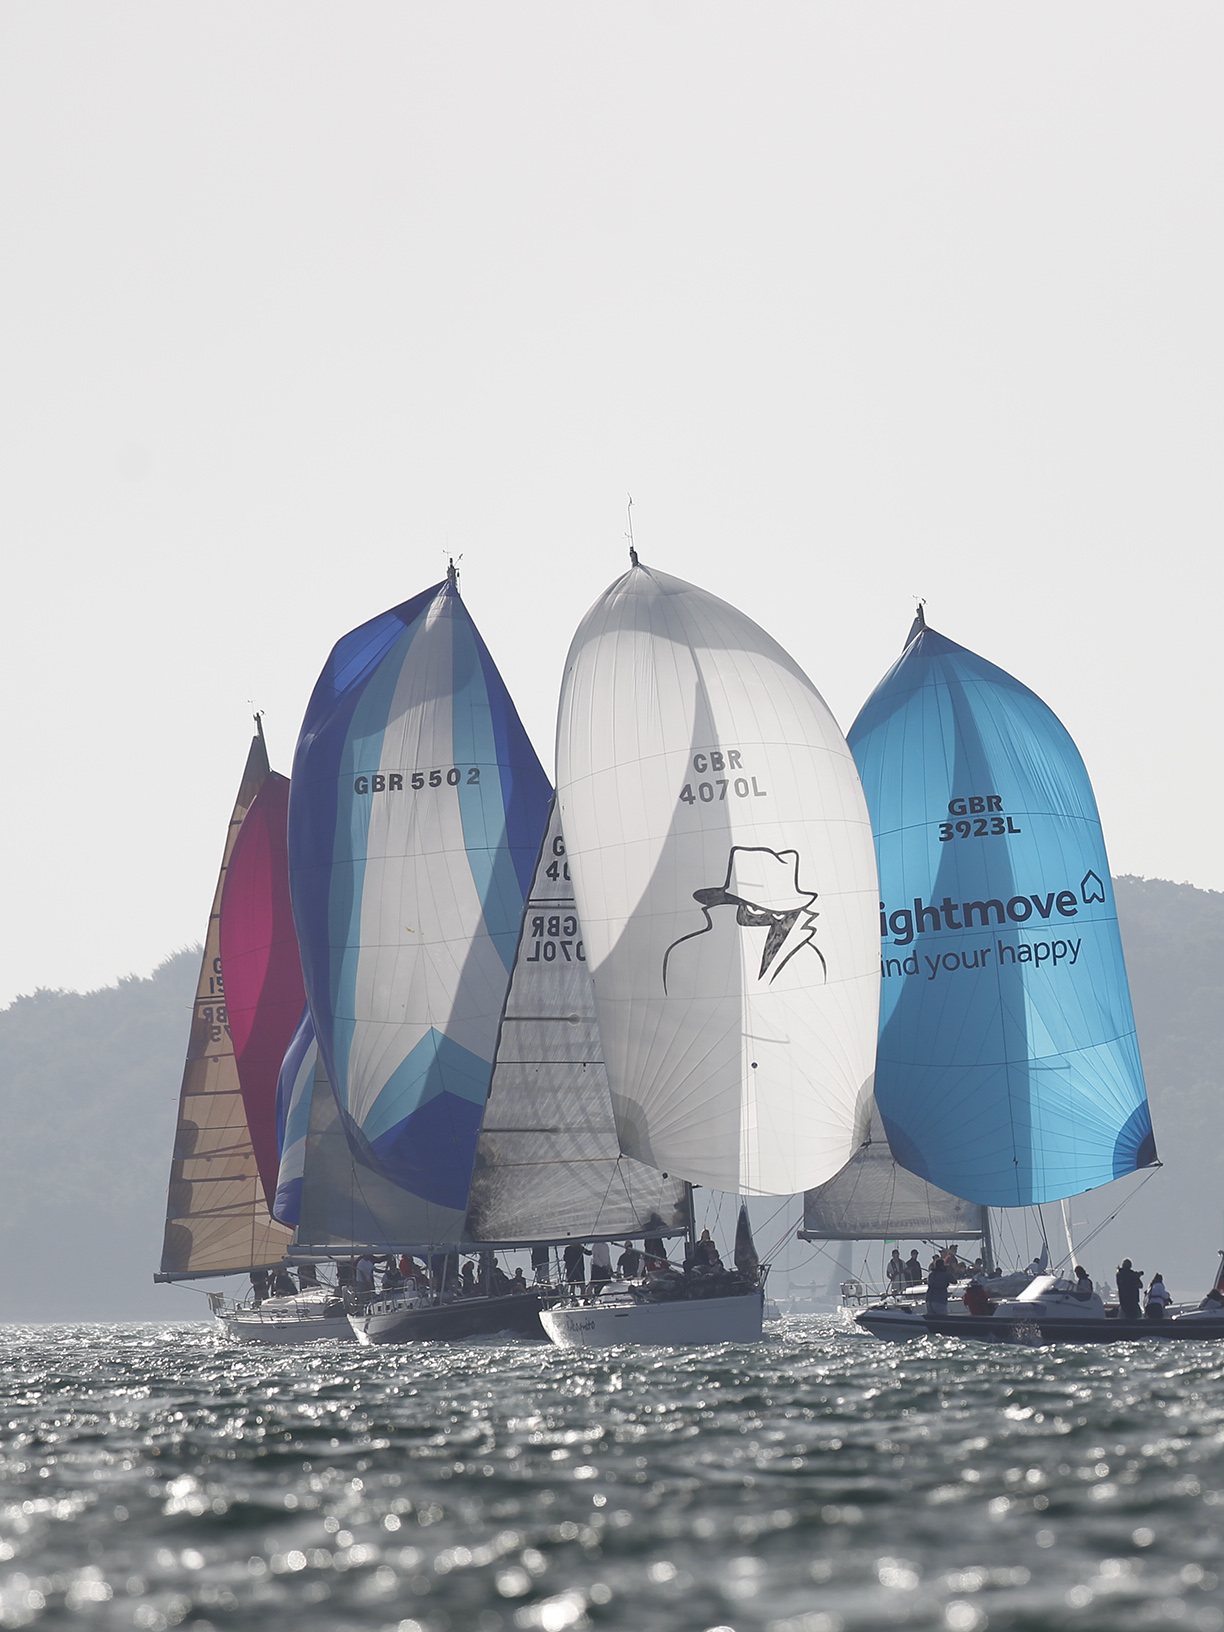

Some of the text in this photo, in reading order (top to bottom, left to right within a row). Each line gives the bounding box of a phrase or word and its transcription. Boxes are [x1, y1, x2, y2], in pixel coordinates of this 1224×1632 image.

[693, 750, 743, 773] GBR
[354, 768, 480, 795] GBR 5502
[679, 776, 767, 805] 4070L
[948, 795, 1003, 816] GBR
[938, 816, 1021, 842] 3923L
[880, 890, 1079, 946] ightmove
[881, 938, 1082, 980] ind your happy
